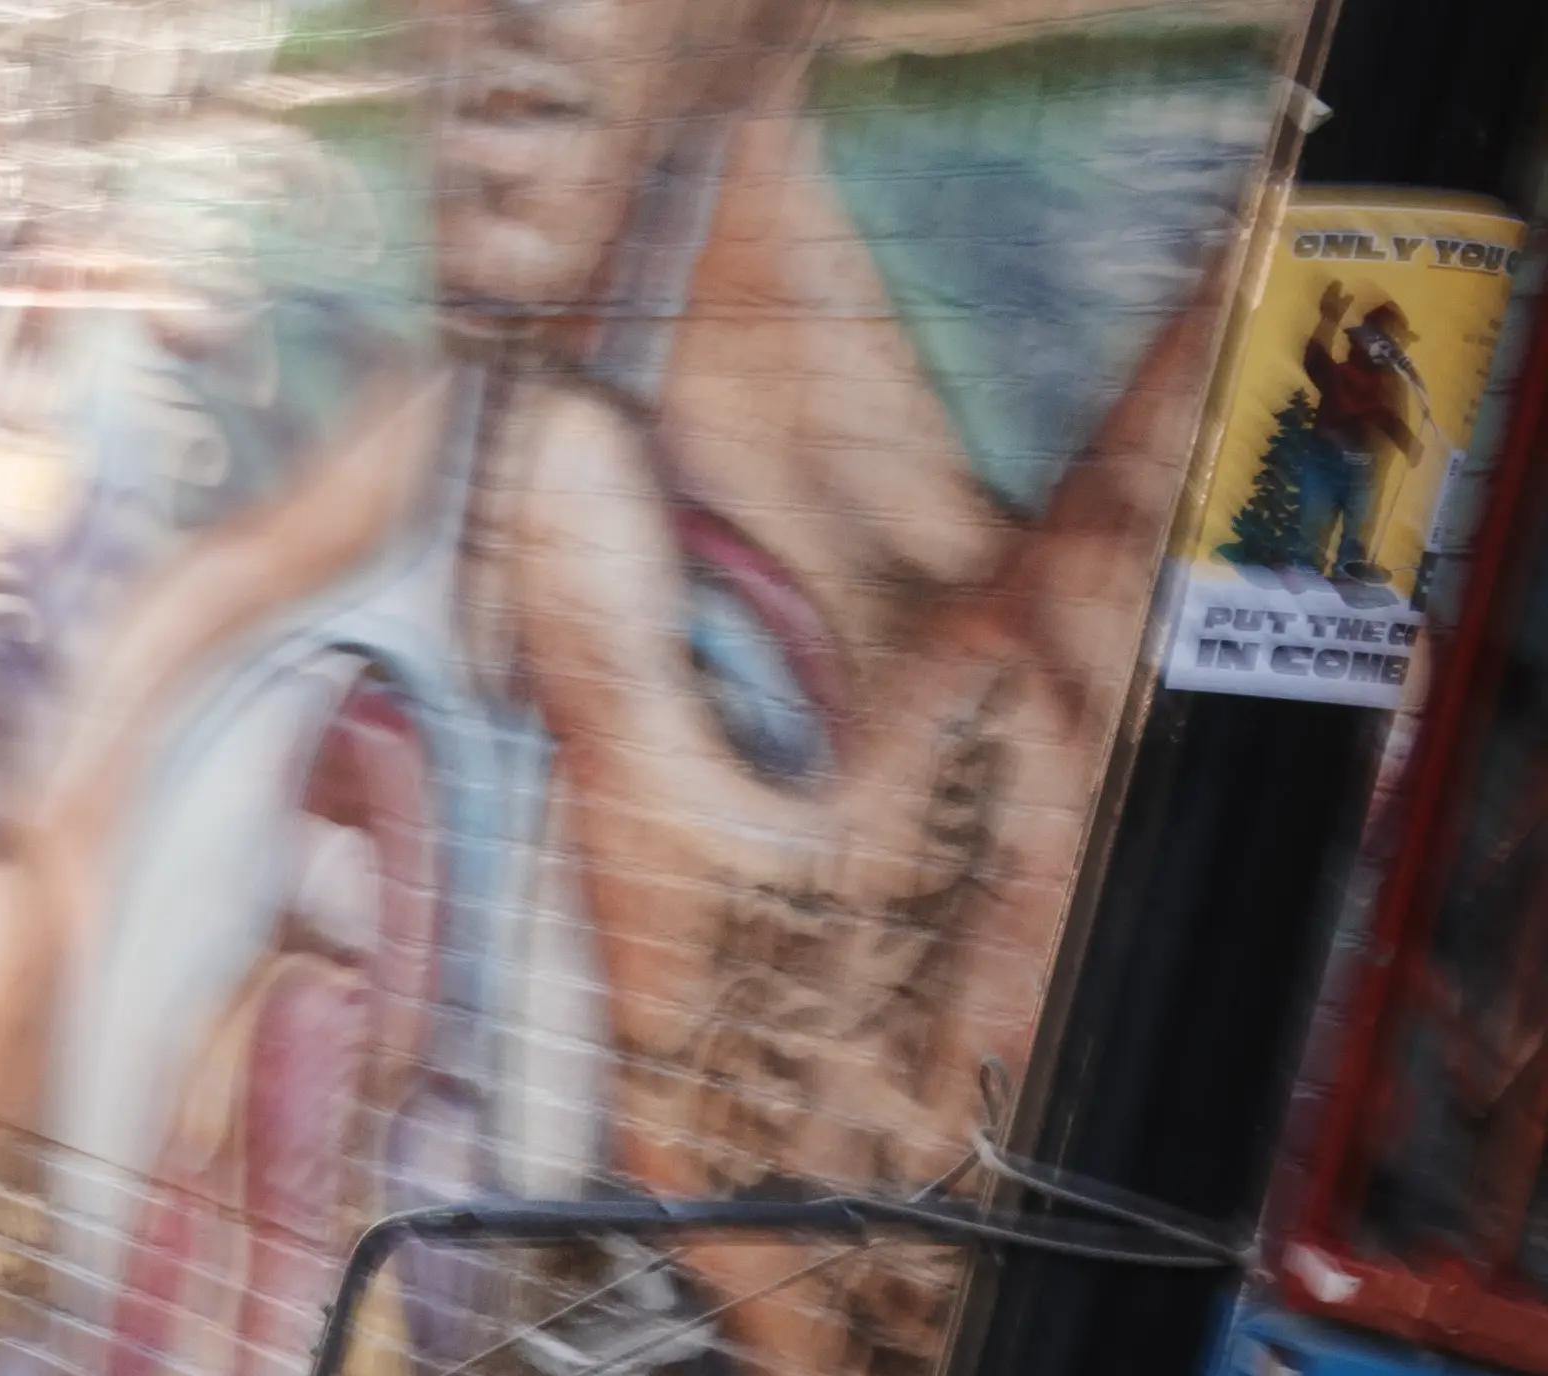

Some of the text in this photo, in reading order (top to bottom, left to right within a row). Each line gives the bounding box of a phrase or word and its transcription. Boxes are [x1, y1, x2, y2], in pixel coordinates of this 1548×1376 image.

[1294, 232, 1426, 263] ONLY
[1434, 239, 1507, 272] YOU
[1204, 606, 1298, 634] PUT
[1307, 614, 1387, 644] THE
[1195, 637, 1261, 671] IN
